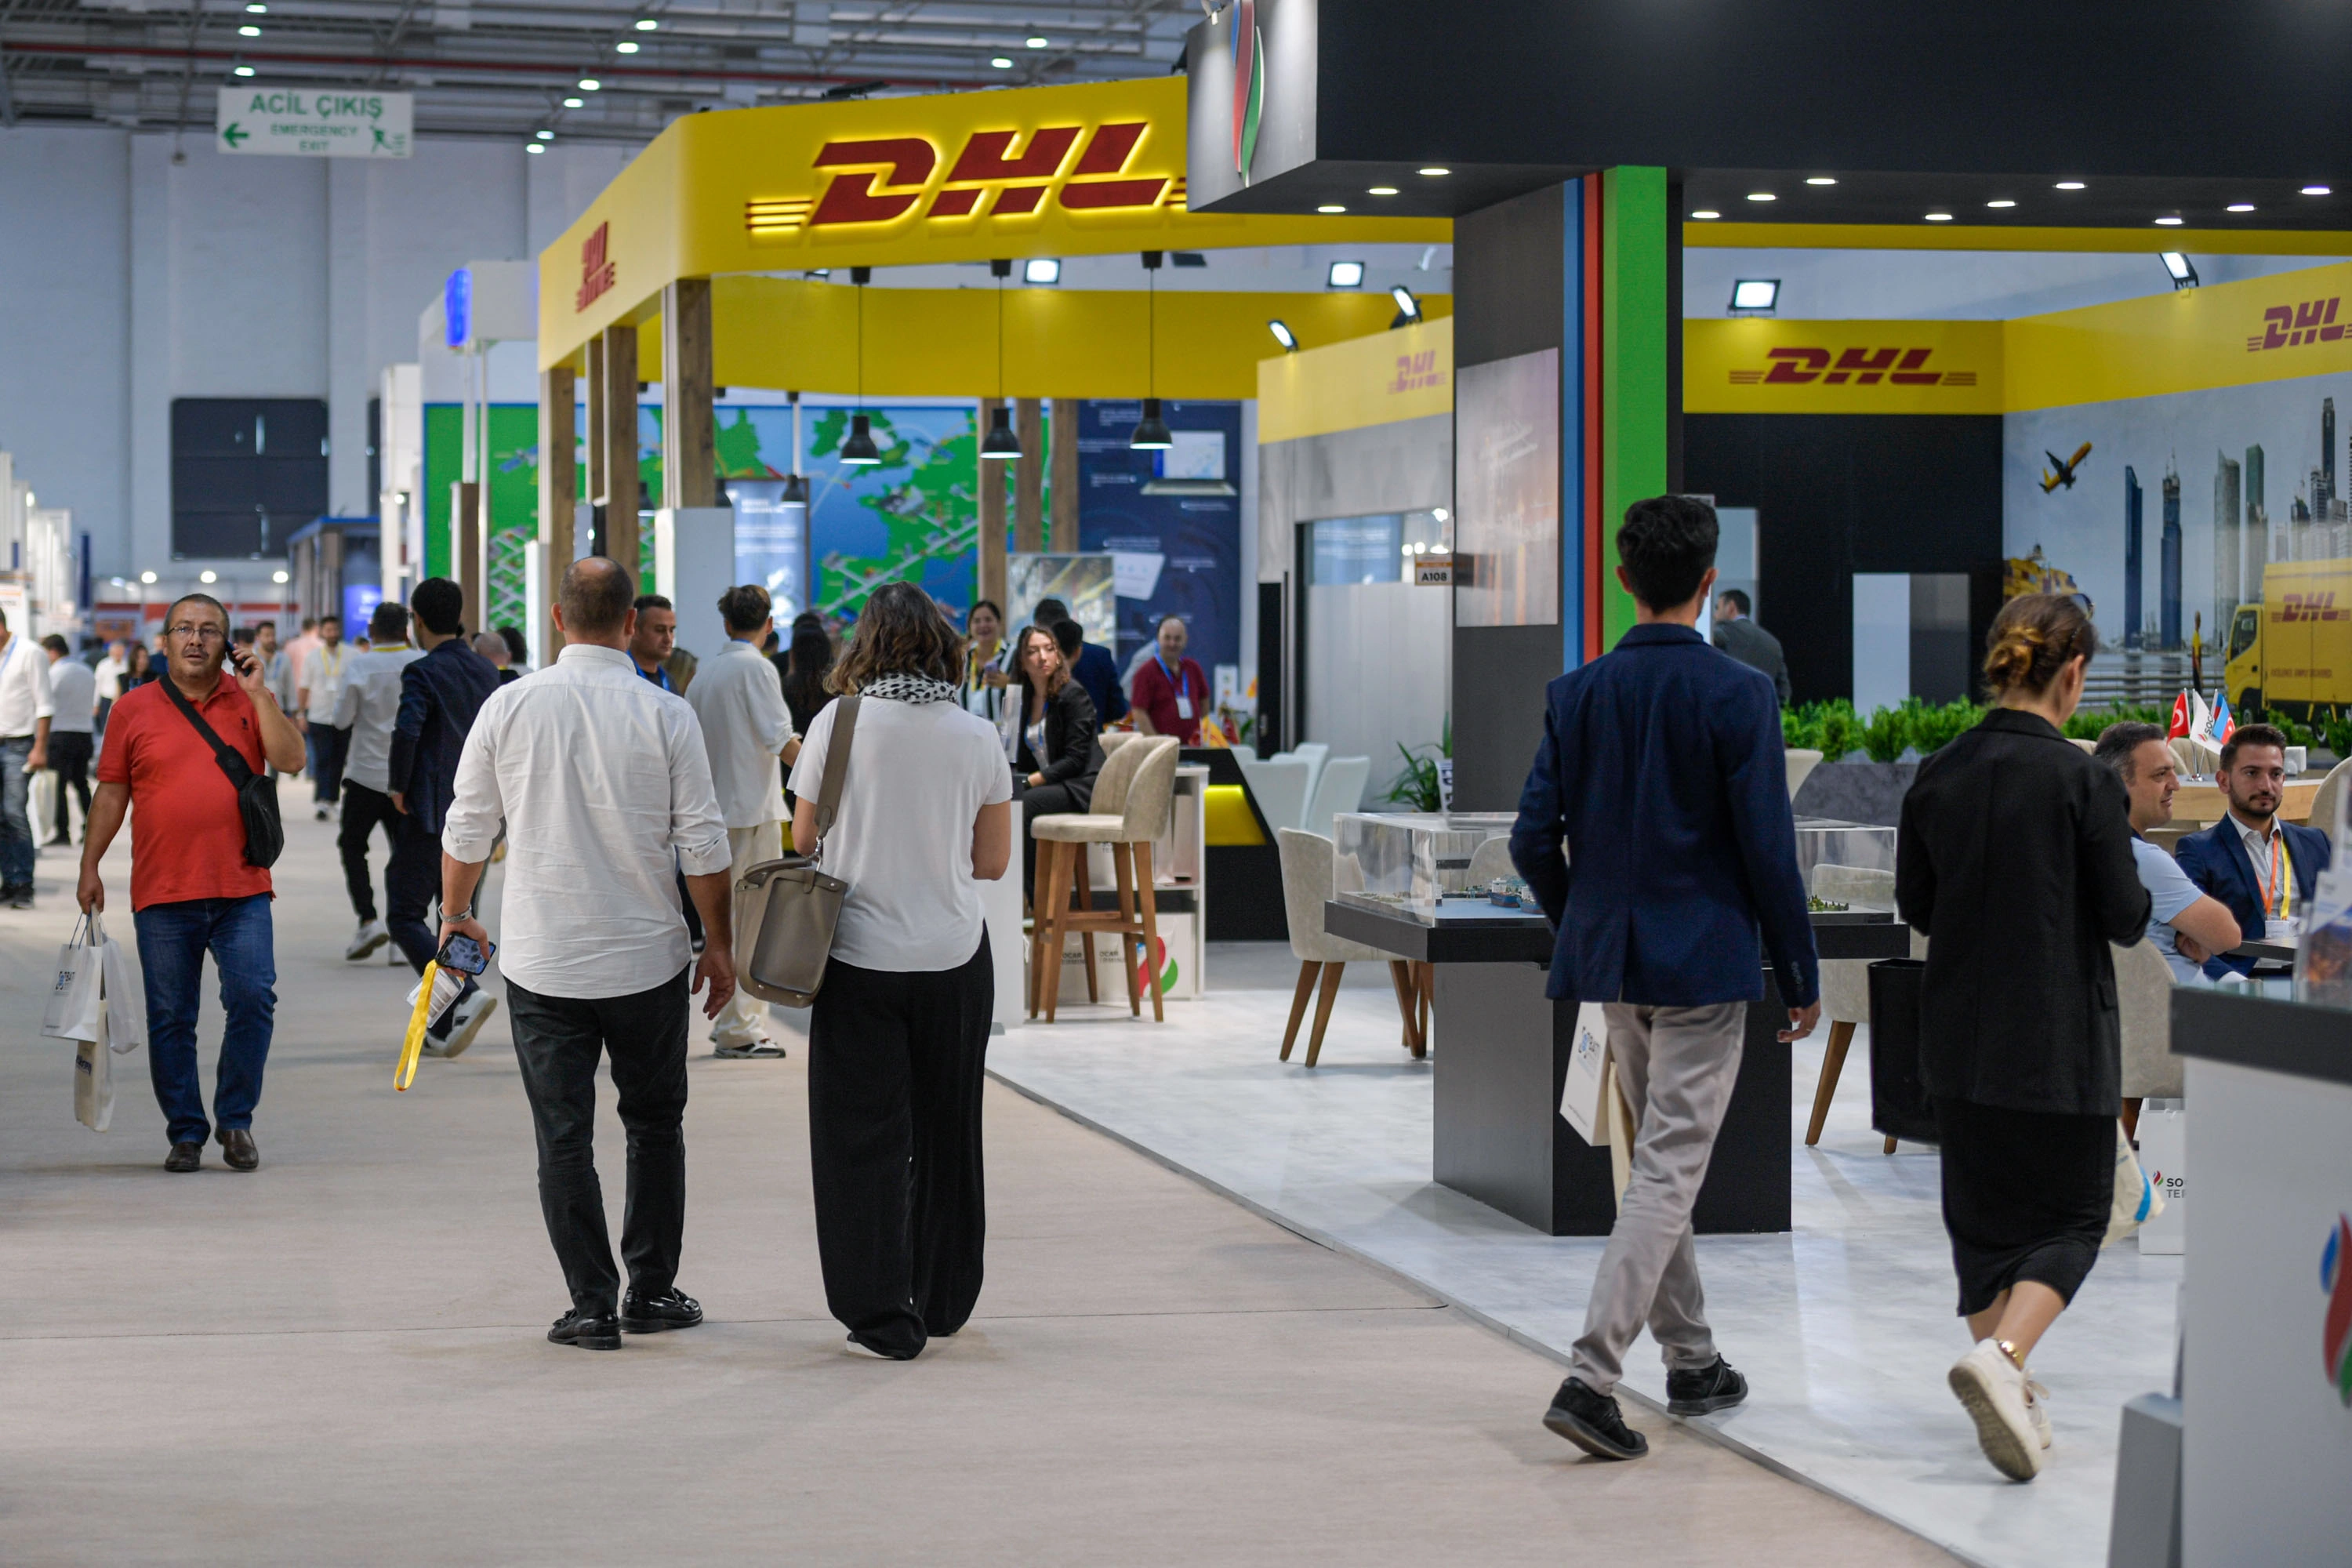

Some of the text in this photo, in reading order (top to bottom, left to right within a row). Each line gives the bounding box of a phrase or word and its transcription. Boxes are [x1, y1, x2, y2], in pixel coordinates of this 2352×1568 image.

[249, 90, 383, 120] ACİL ÇIKIŞ
[271, 124, 358, 136] EMERGENCY
[299, 140, 329, 152] EXIT
[808, 122, 1169, 225] DHL
[2262, 297, 2346, 350] DHL
[1396, 350, 1438, 393] DHL
[1764, 347, 1943, 386] DHL
[1421, 572, 1447, 582] A108
[2282, 592, 2339, 622] DHL
[2166, 1178, 2185, 1188] SO
